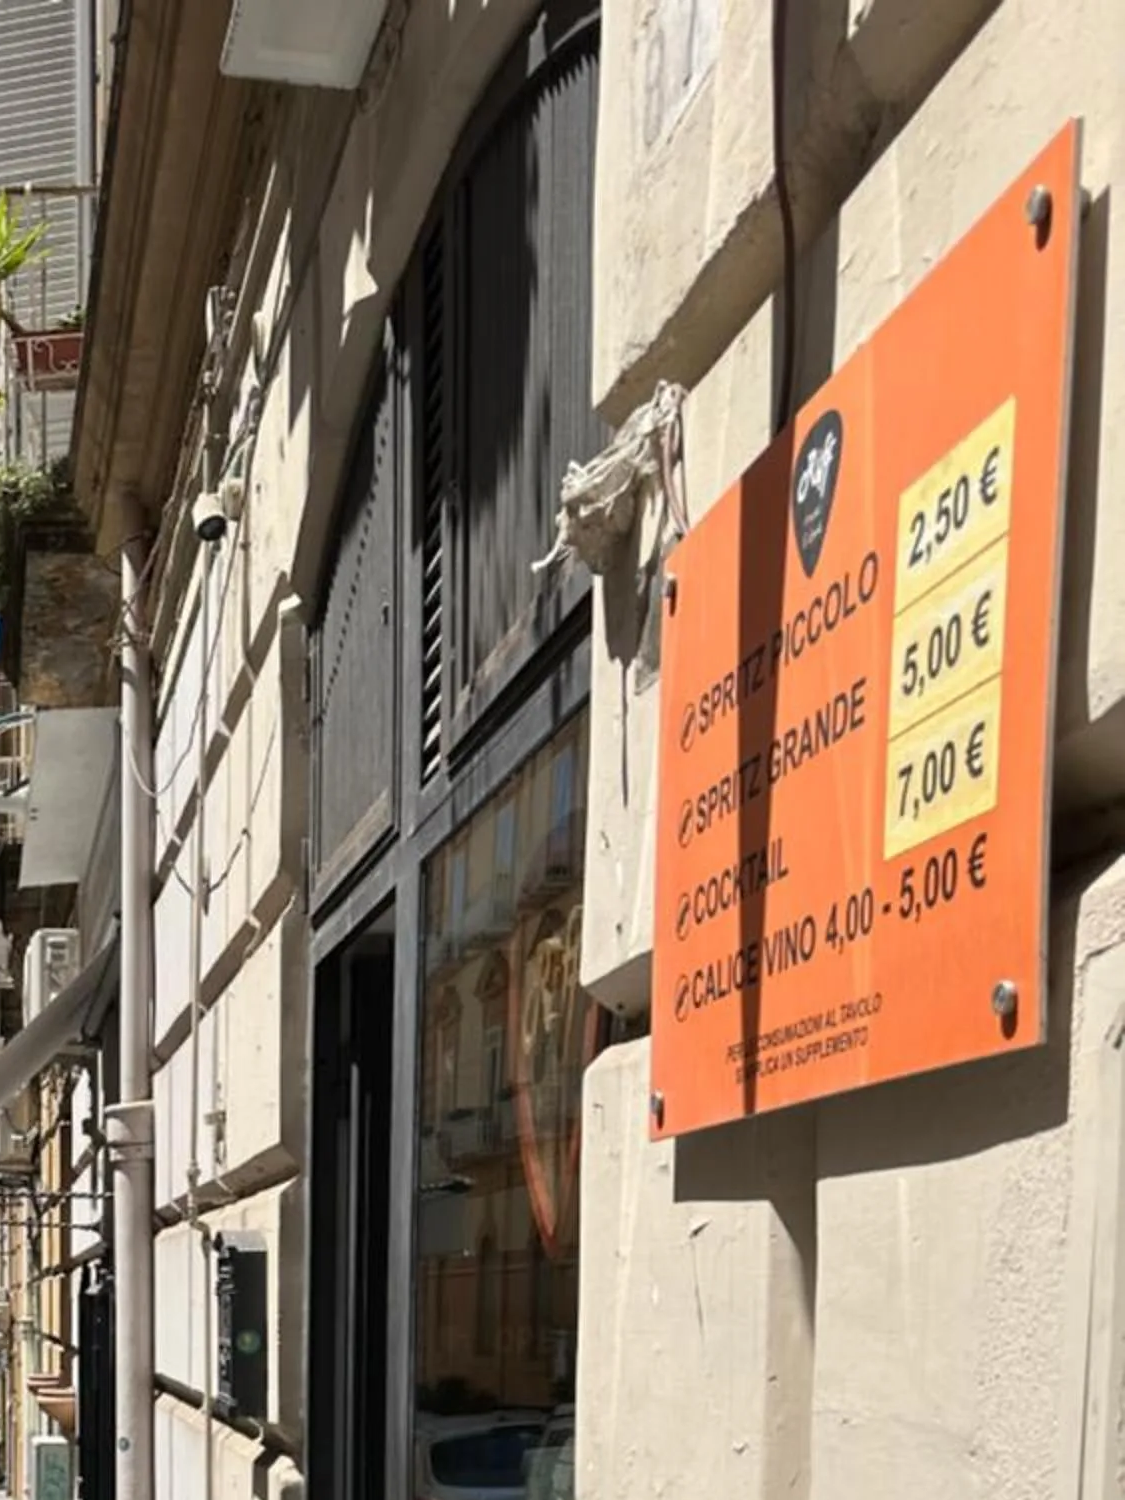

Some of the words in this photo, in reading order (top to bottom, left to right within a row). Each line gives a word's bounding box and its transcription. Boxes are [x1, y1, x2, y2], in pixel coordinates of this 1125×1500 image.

[698, 643, 766, 735] SPRITZ
[771, 551, 879, 675] PICCOLO
[907, 475, 970, 567] 2,50
[979, 446, 1001, 506] €
[693, 837, 789, 925] COCKTAIL
[897, 740, 956, 820] 7,00
[965, 721, 986, 779] €
[696, 752, 761, 834] SPRITZ
[767, 676, 867, 785] GRANDE
[901, 612, 962, 697] 5,00
[971, 590, 992, 648] €
[691, 942, 760, 1010] CALICE
[761, 915, 817, 977] VINO
[825, 887, 874, 955] 4,00
[899, 848, 958, 923] 5,00
[967, 832, 987, 889] €
